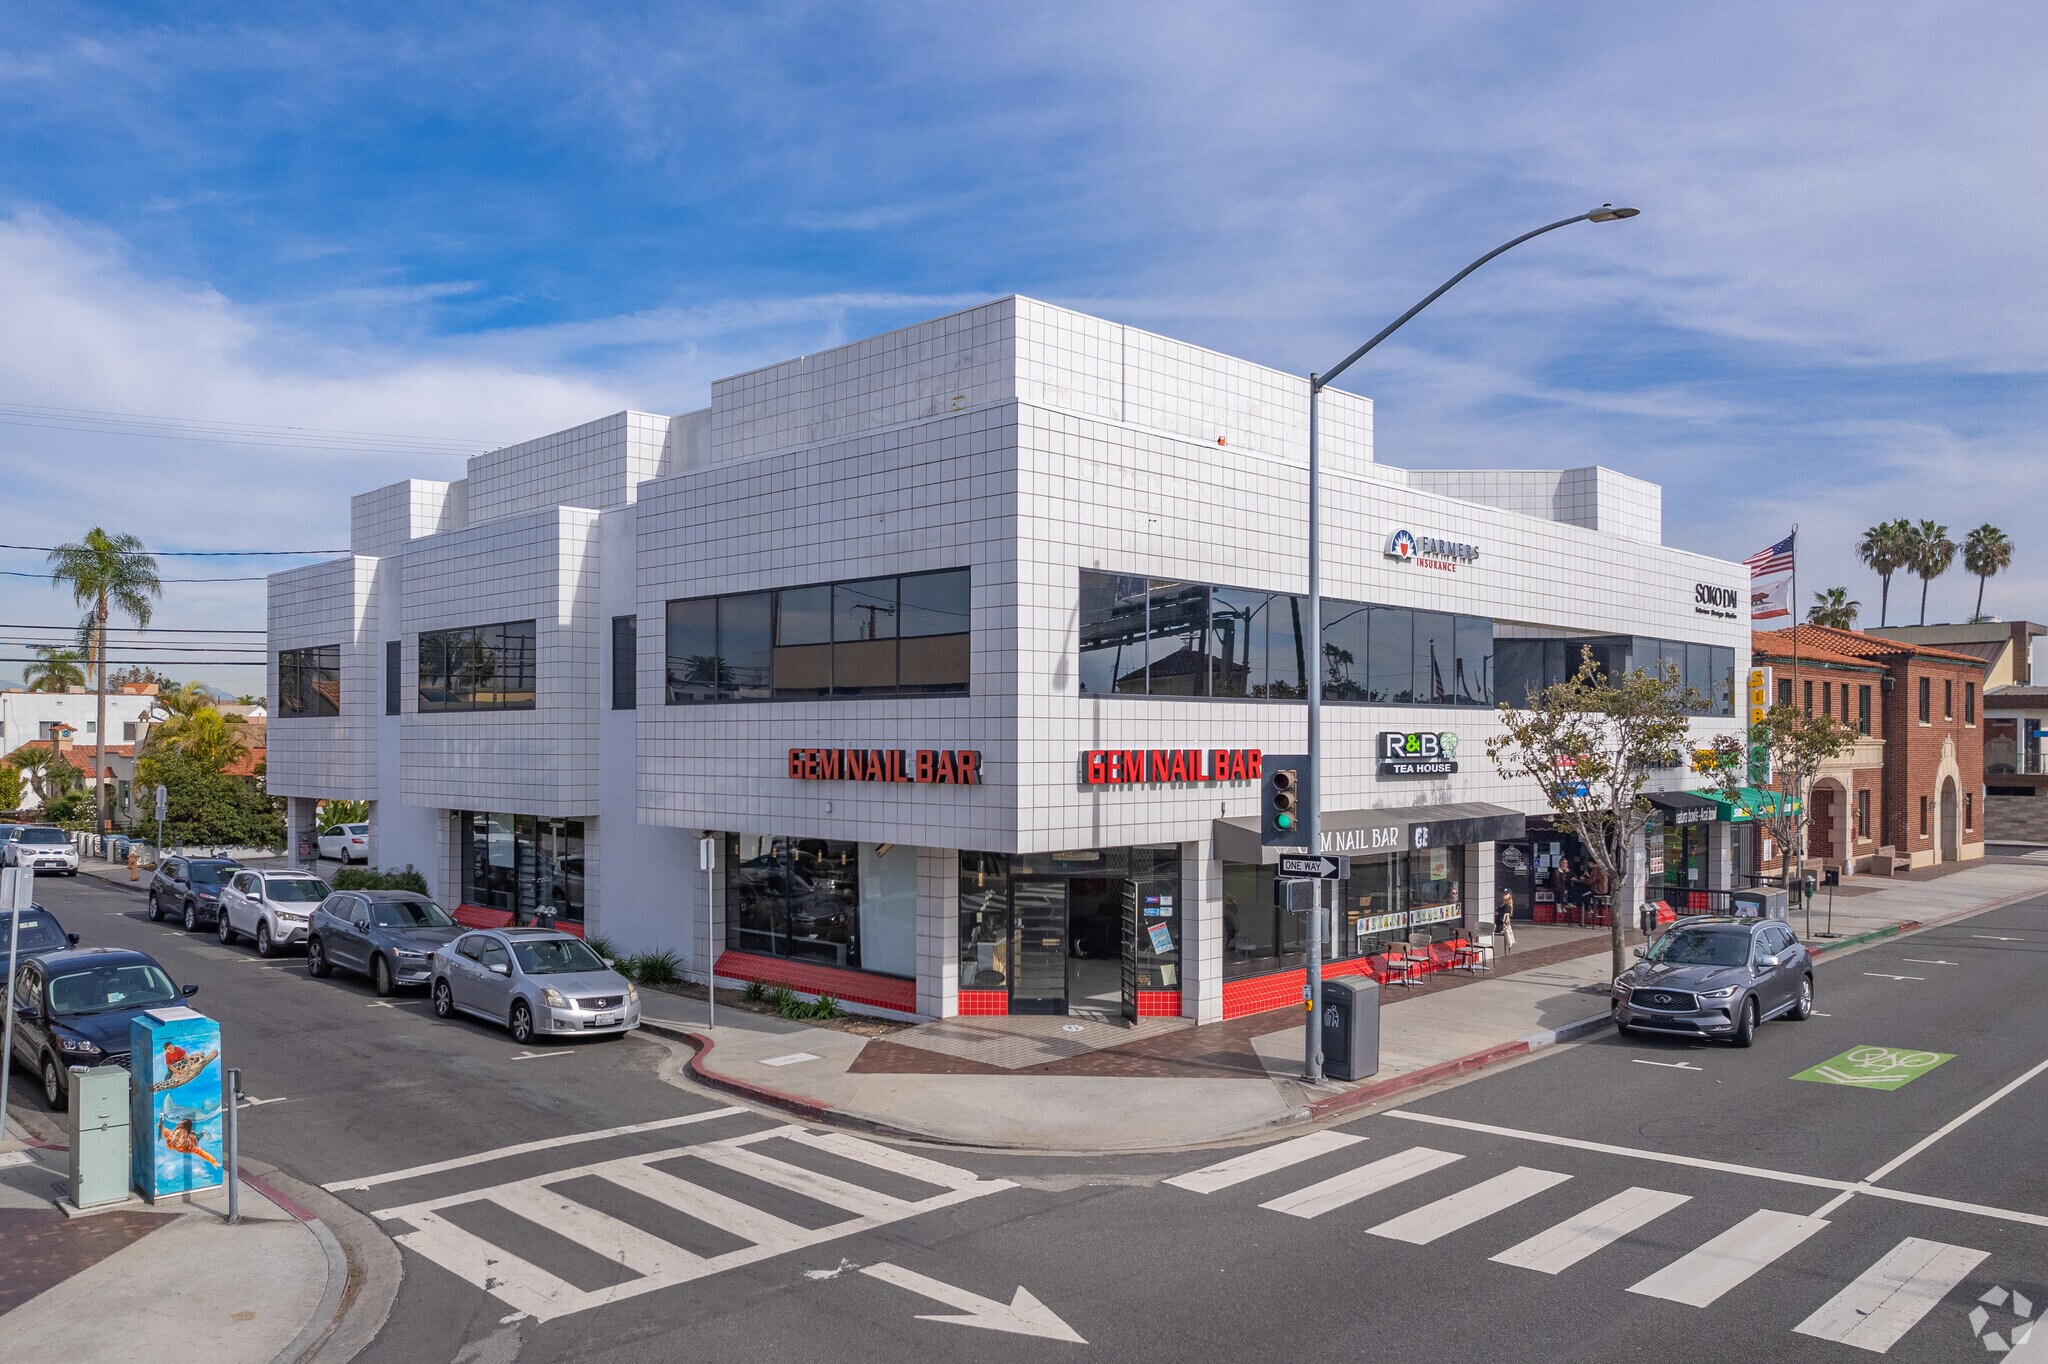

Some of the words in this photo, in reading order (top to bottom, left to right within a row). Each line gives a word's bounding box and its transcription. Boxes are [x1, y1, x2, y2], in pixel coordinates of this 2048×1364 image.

[1423, 537, 1479, 560] FARMERS
[1416, 558, 1456, 572] INSURANCE
[1695, 583, 1722, 607] SOKO
[1723, 588, 1737, 608] DAI
[1386, 733, 1439, 757] R&B
[788, 748, 841, 780] GEM
[846, 749, 909, 782] NAIL
[915, 750, 978, 784] BAR
[1087, 749, 1145, 784] GEM
[1151, 749, 1210, 782] NAIL
[1215, 749, 1262, 781] BAR
[1393, 764, 1414, 773] TEA
[1416, 763, 1451, 773] HOUSE
[1335, 829, 1368, 852] NAIL
[1371, 827, 1399, 848] BAR
[1285, 860, 1302, 871] ONE
[1304, 861, 1321, 871] WAY
